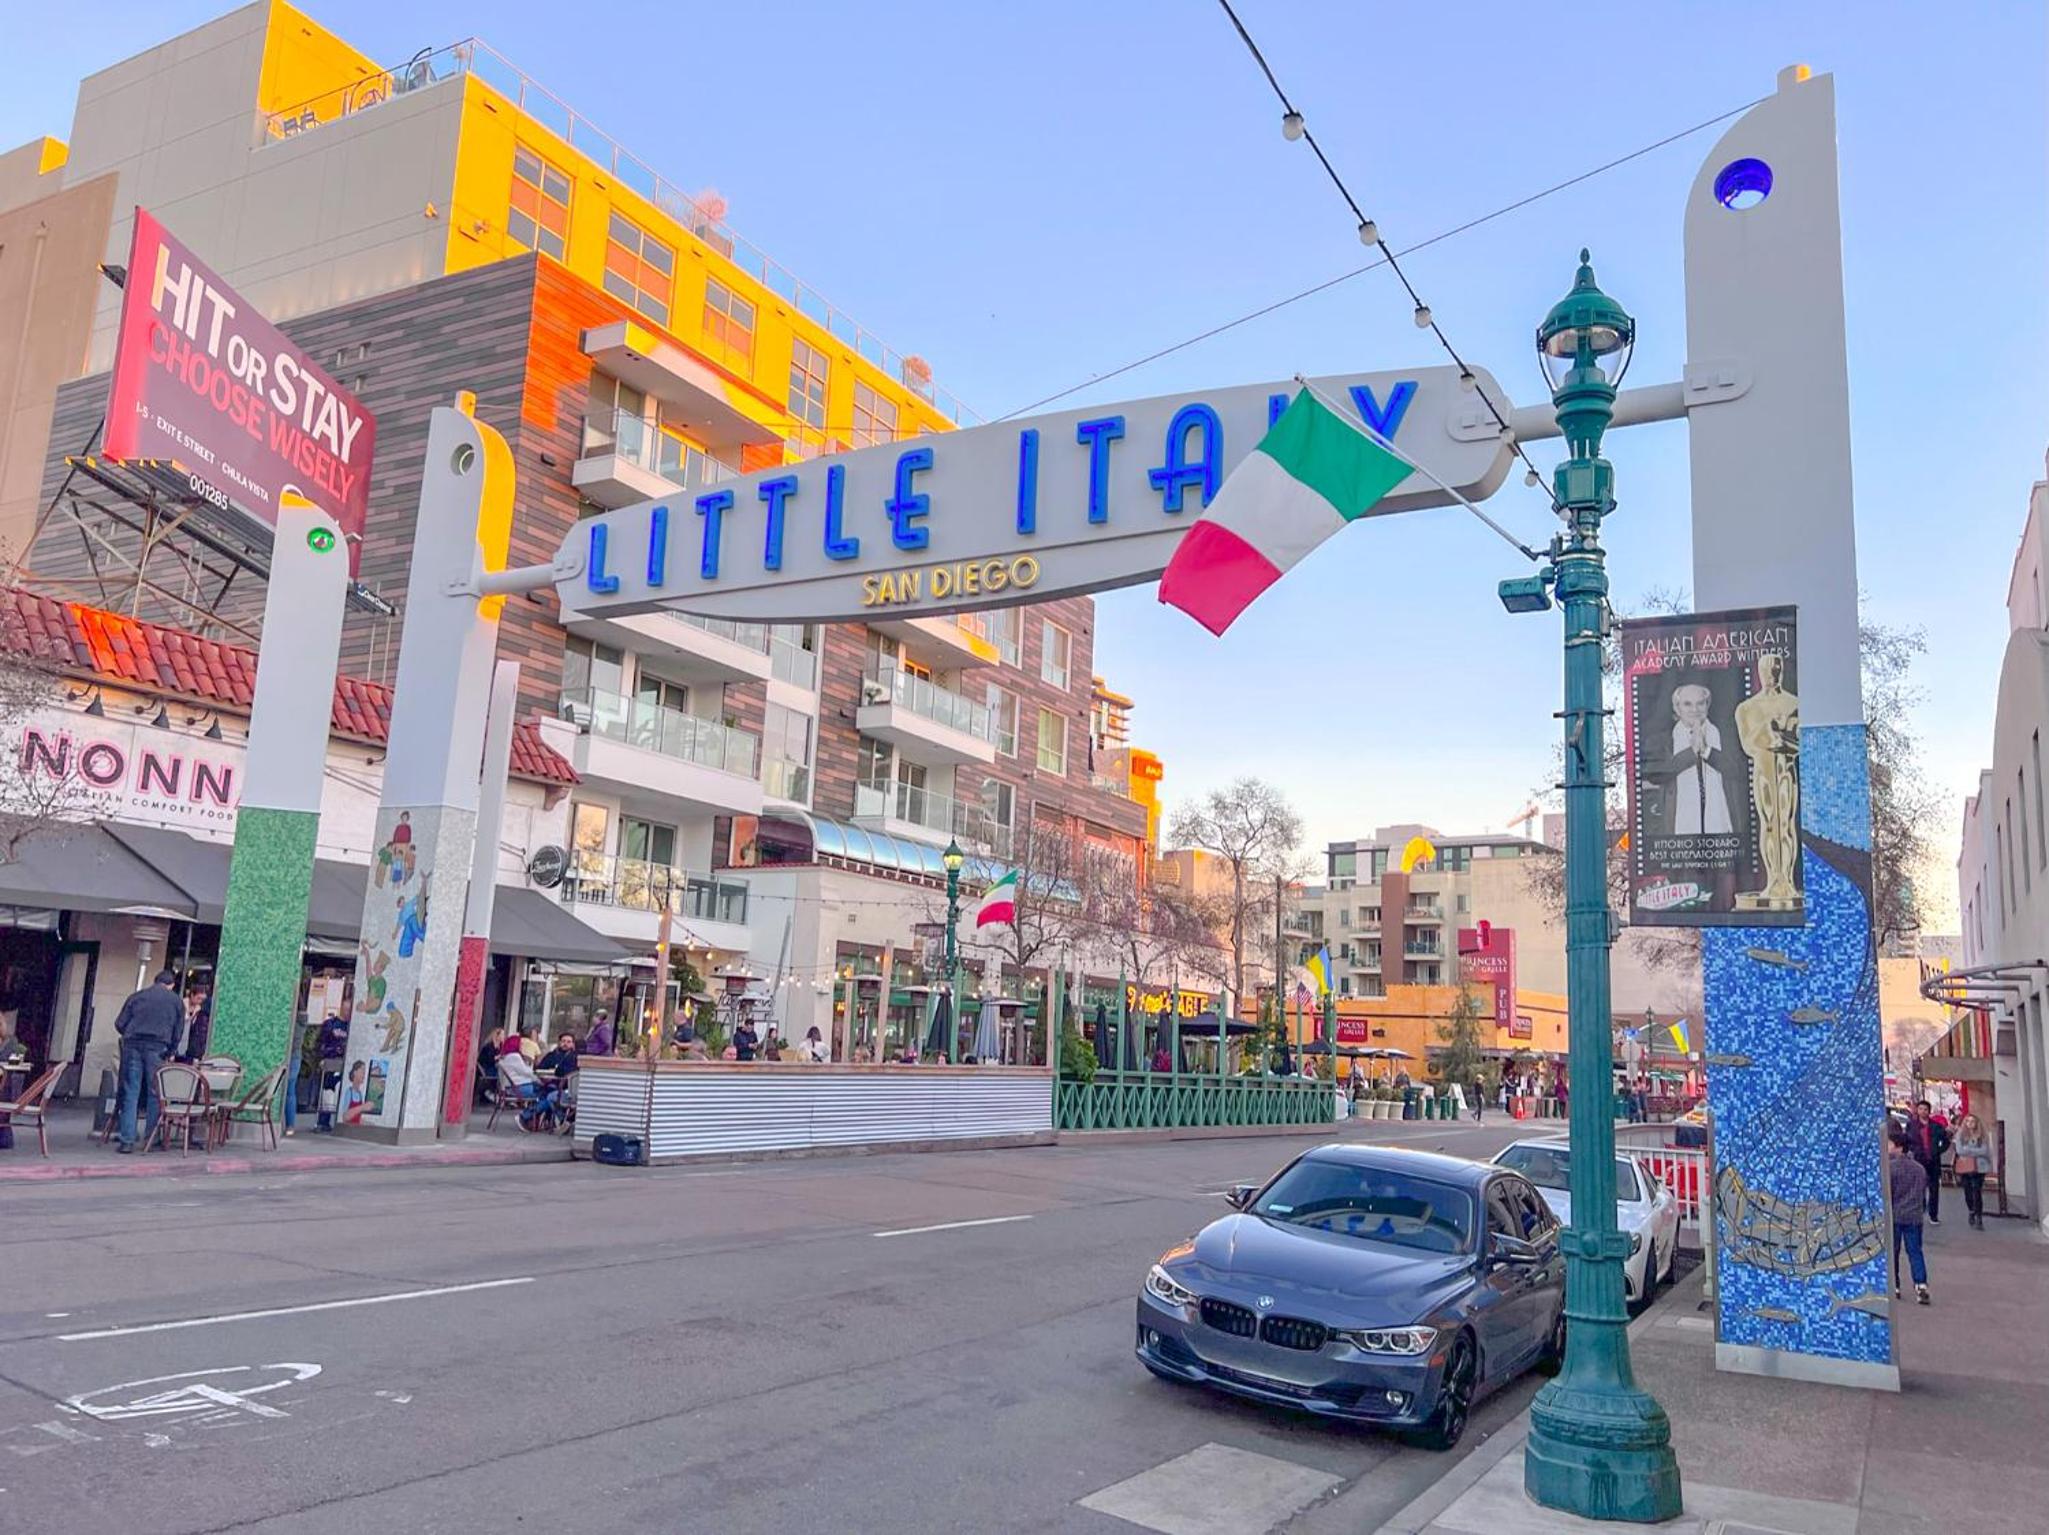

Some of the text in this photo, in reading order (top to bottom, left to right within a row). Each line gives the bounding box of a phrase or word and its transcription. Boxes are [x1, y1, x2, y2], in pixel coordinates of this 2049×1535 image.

[151, 243, 363, 464] HIT OR STAY
[148, 320, 354, 503] CHOOSE WISELY
[157, 416, 176, 437] EXIT
[176, 430, 183, 443] E
[183, 435, 216, 464] STREET
[222, 462, 247, 487] CHULA
[248, 480, 270, 502] VISTA
[189, 474, 228, 510] 001285
[588, 447, 934, 595] LITTLE
[863, 554, 1041, 608] SAN DIEGO
[1633, 646, 1790, 670] ACADEMY AWARD WINNERS
[1634, 627, 1788, 656] ITALIAN AMERICAN
[19, 727, 240, 808] NONN
[131, 798, 193, 814] COMFORT
[200, 808, 234, 821] FOOD
